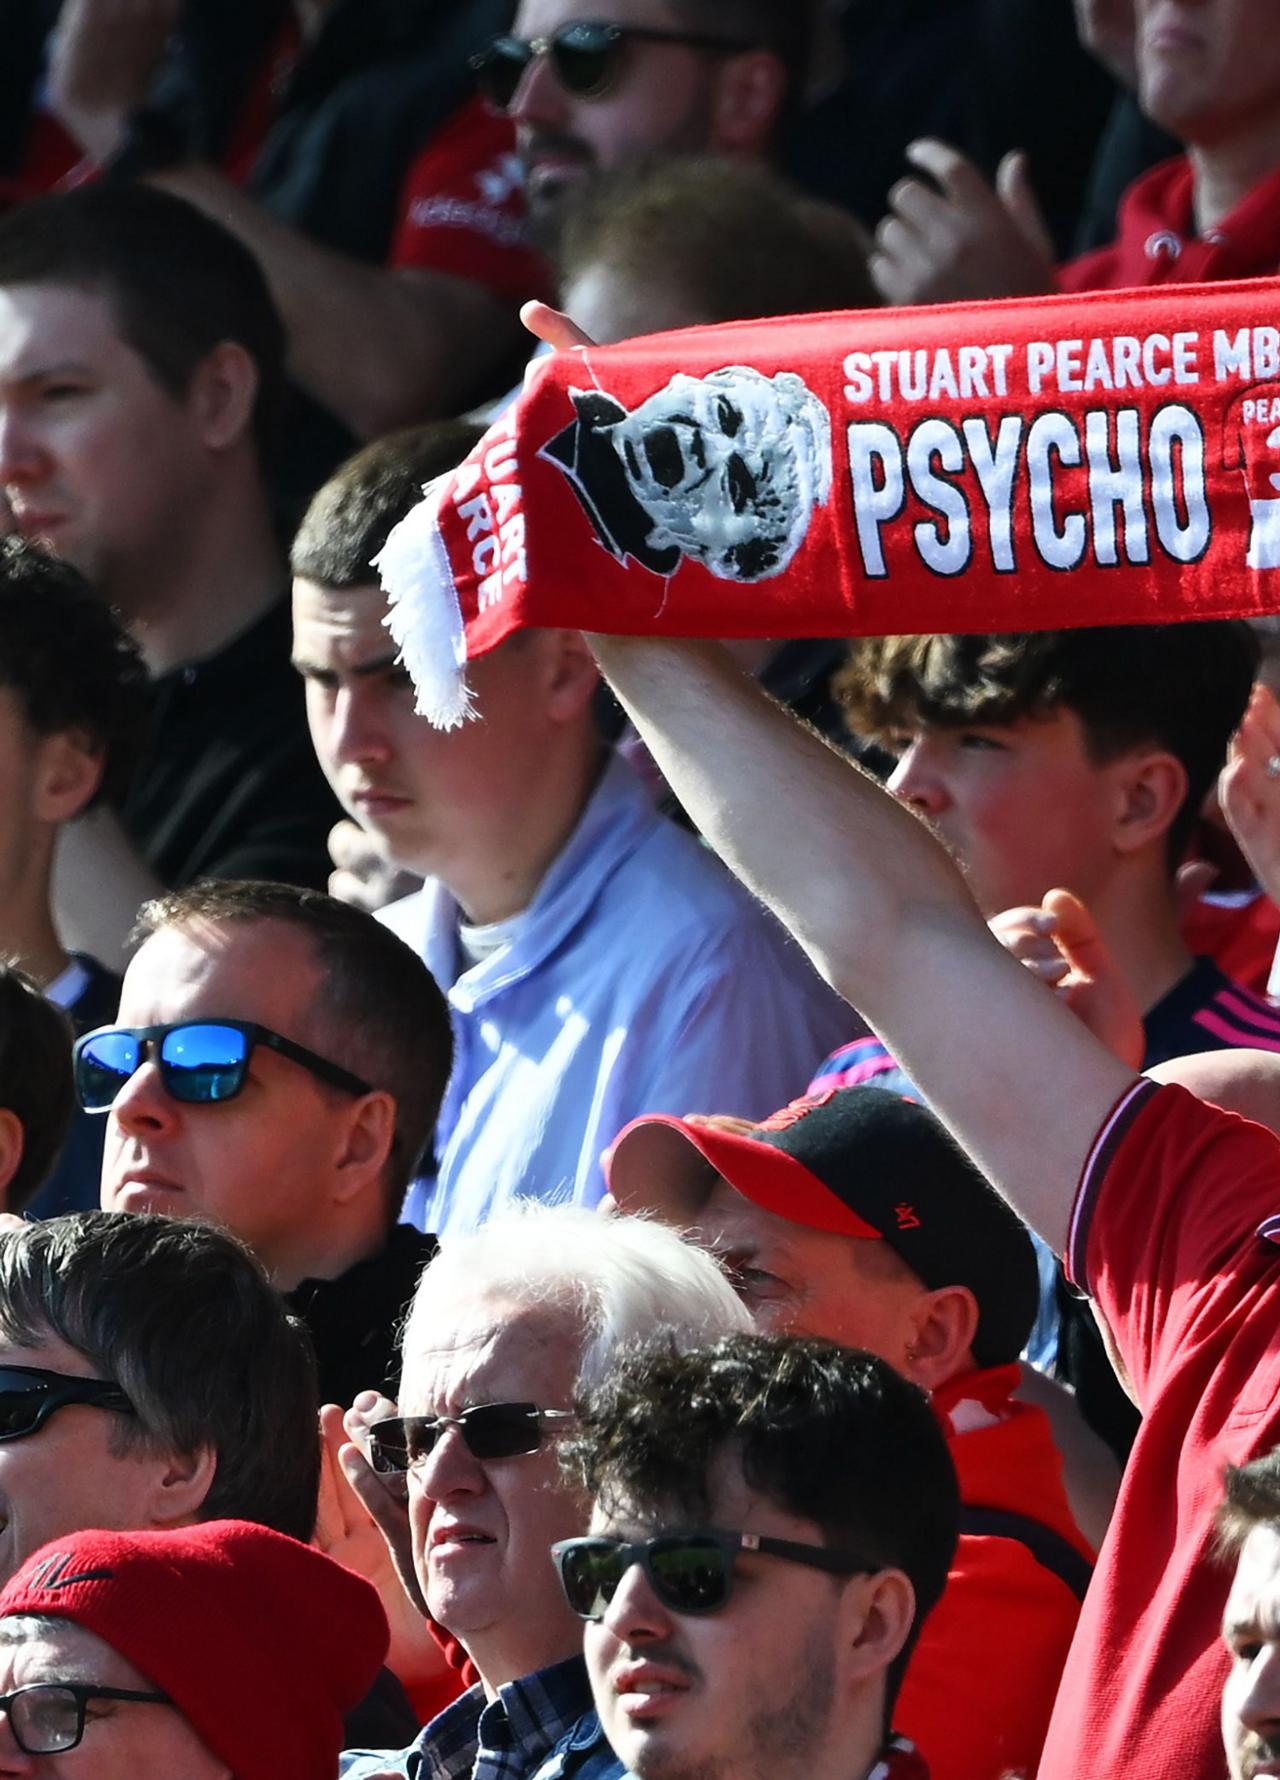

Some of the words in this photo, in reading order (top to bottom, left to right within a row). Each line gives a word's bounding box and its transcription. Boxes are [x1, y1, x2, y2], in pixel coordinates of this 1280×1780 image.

[843, 344, 1013, 402] STUART
[1027, 332, 1200, 394] PEARCE
[846, 403, 1211, 578] PSYCHO
